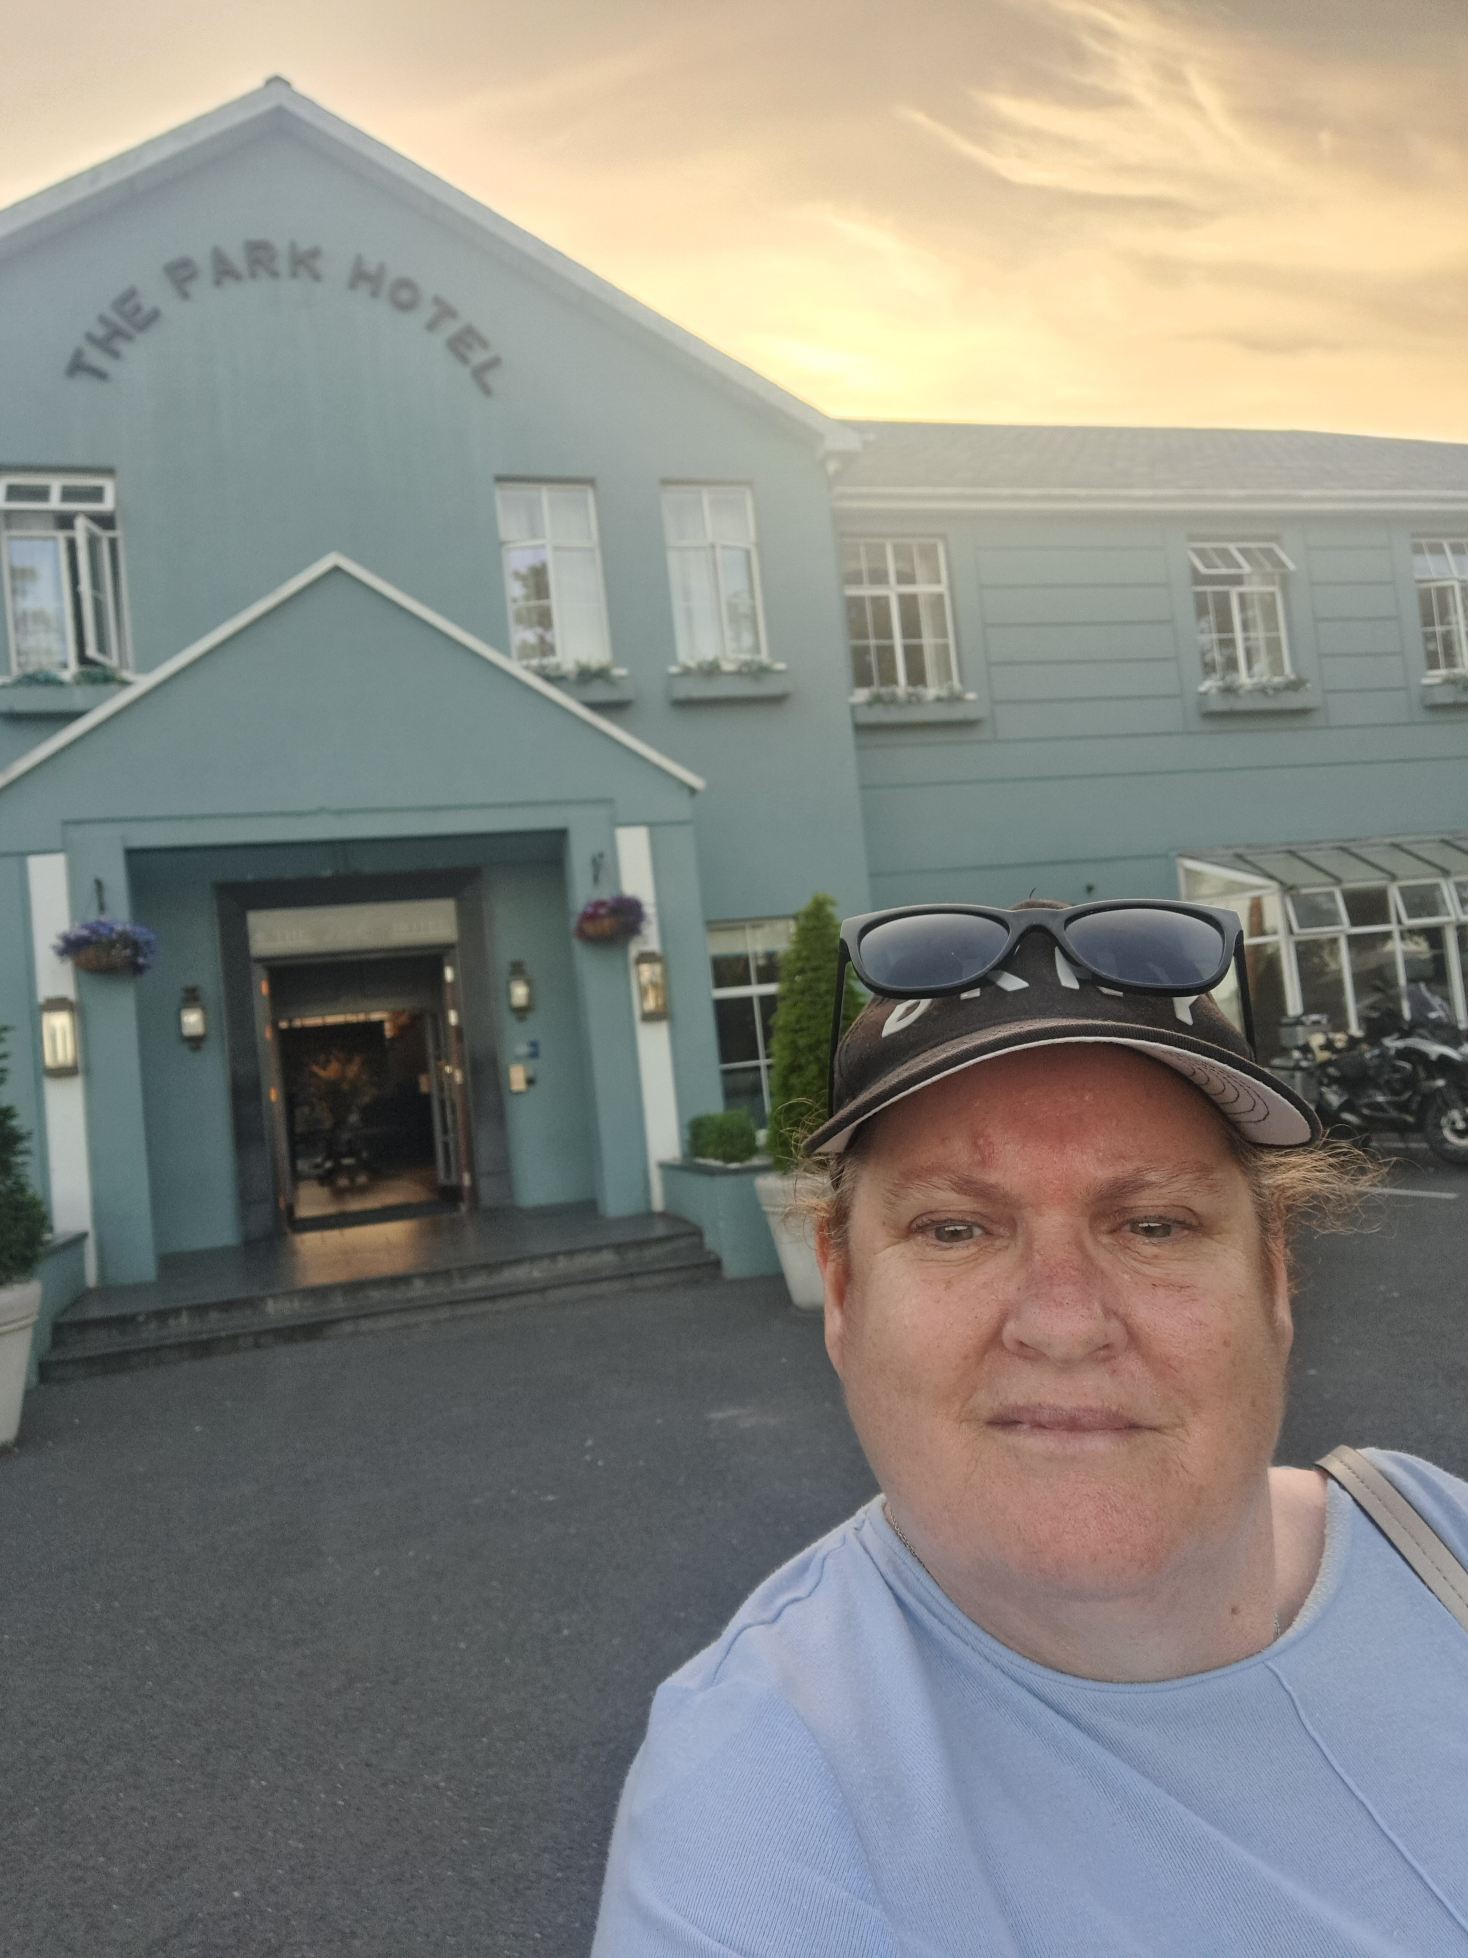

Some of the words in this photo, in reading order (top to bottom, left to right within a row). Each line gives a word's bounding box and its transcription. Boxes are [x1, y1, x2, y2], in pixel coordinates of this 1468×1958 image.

[65, 285, 162, 382] THE
[162, 238, 323, 301] PARK
[346, 252, 504, 399] HOTEL
